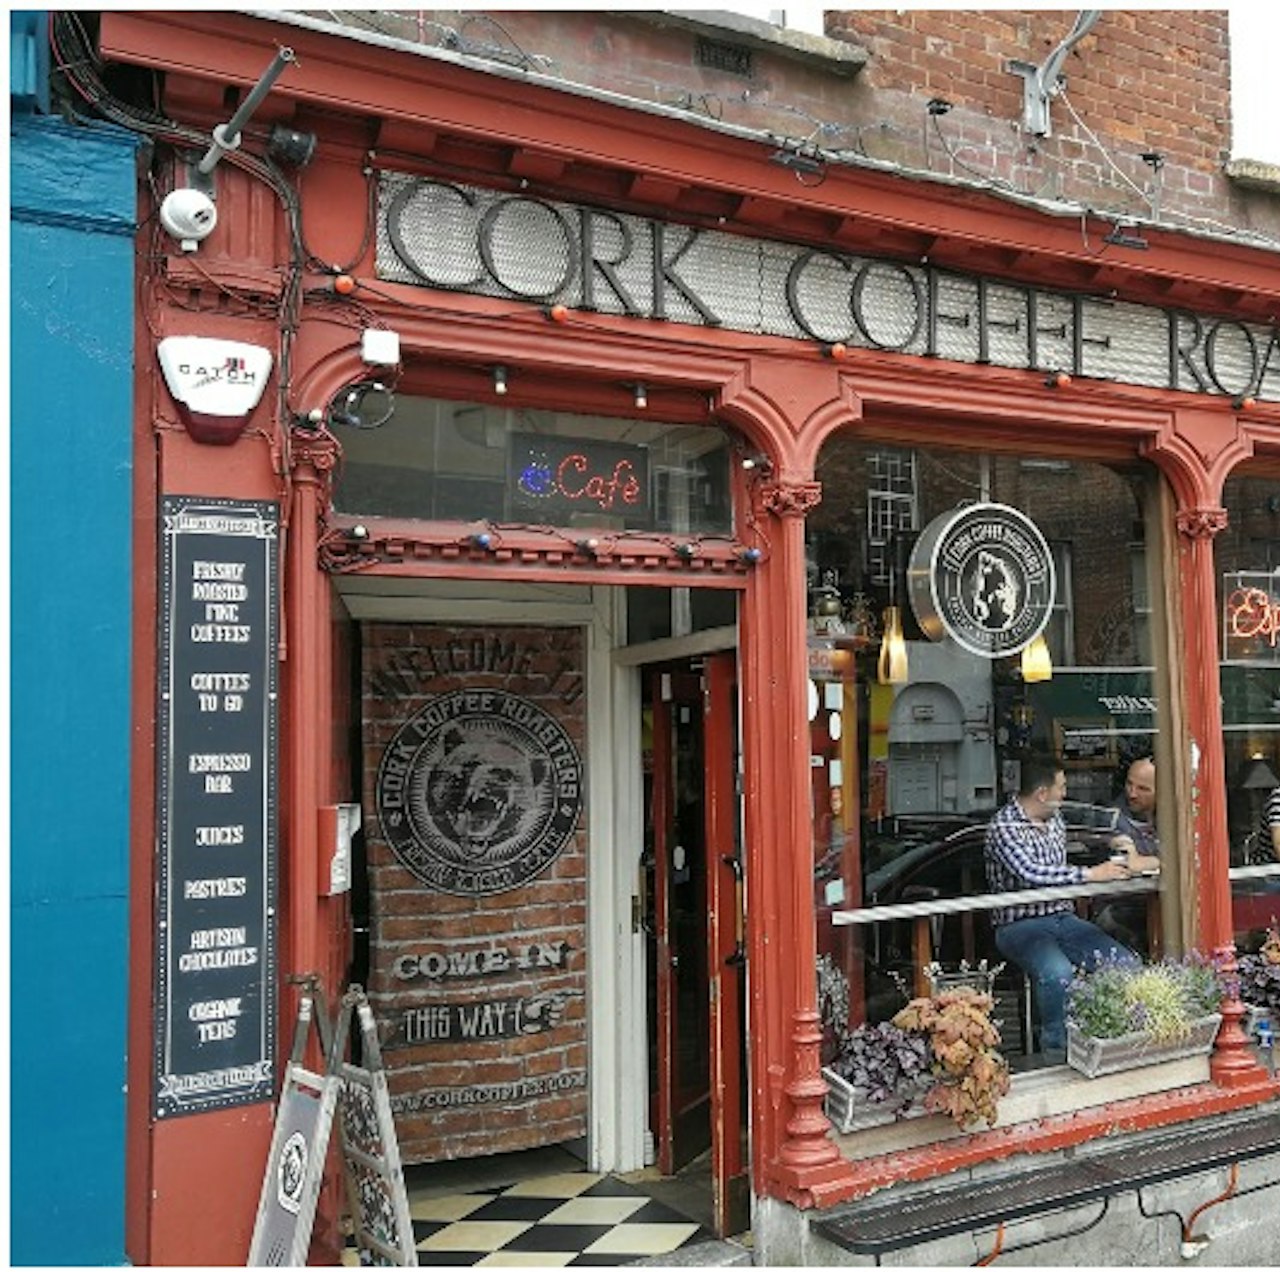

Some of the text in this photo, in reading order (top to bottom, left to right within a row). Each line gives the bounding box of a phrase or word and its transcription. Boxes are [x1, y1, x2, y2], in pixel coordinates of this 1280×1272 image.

[387, 178, 722, 328] CORK
[786, 248, 1110, 377] COFFEE
[192, 583, 248, 602] ROASTED
[191, 625, 251, 643] COFFEES
[199, 694, 244, 712] TO GO
[383, 693, 578, 807] CORK COFFEE ROASTERS
[189, 754, 251, 772] ESPRESSO
[205, 774, 233, 793] BAR
[195, 825, 243, 845] JUICES
[184, 877, 246, 899] PASTRIES
[190, 926, 246, 949] ARTISAN
[178, 947, 258, 972] CHOCOLATES
[393, 940, 570, 981] COME IN
[188, 998, 242, 1022] ORGANIC
[197, 1020, 236, 1043] TEAS
[403, 1002, 507, 1043] THIS WAY
